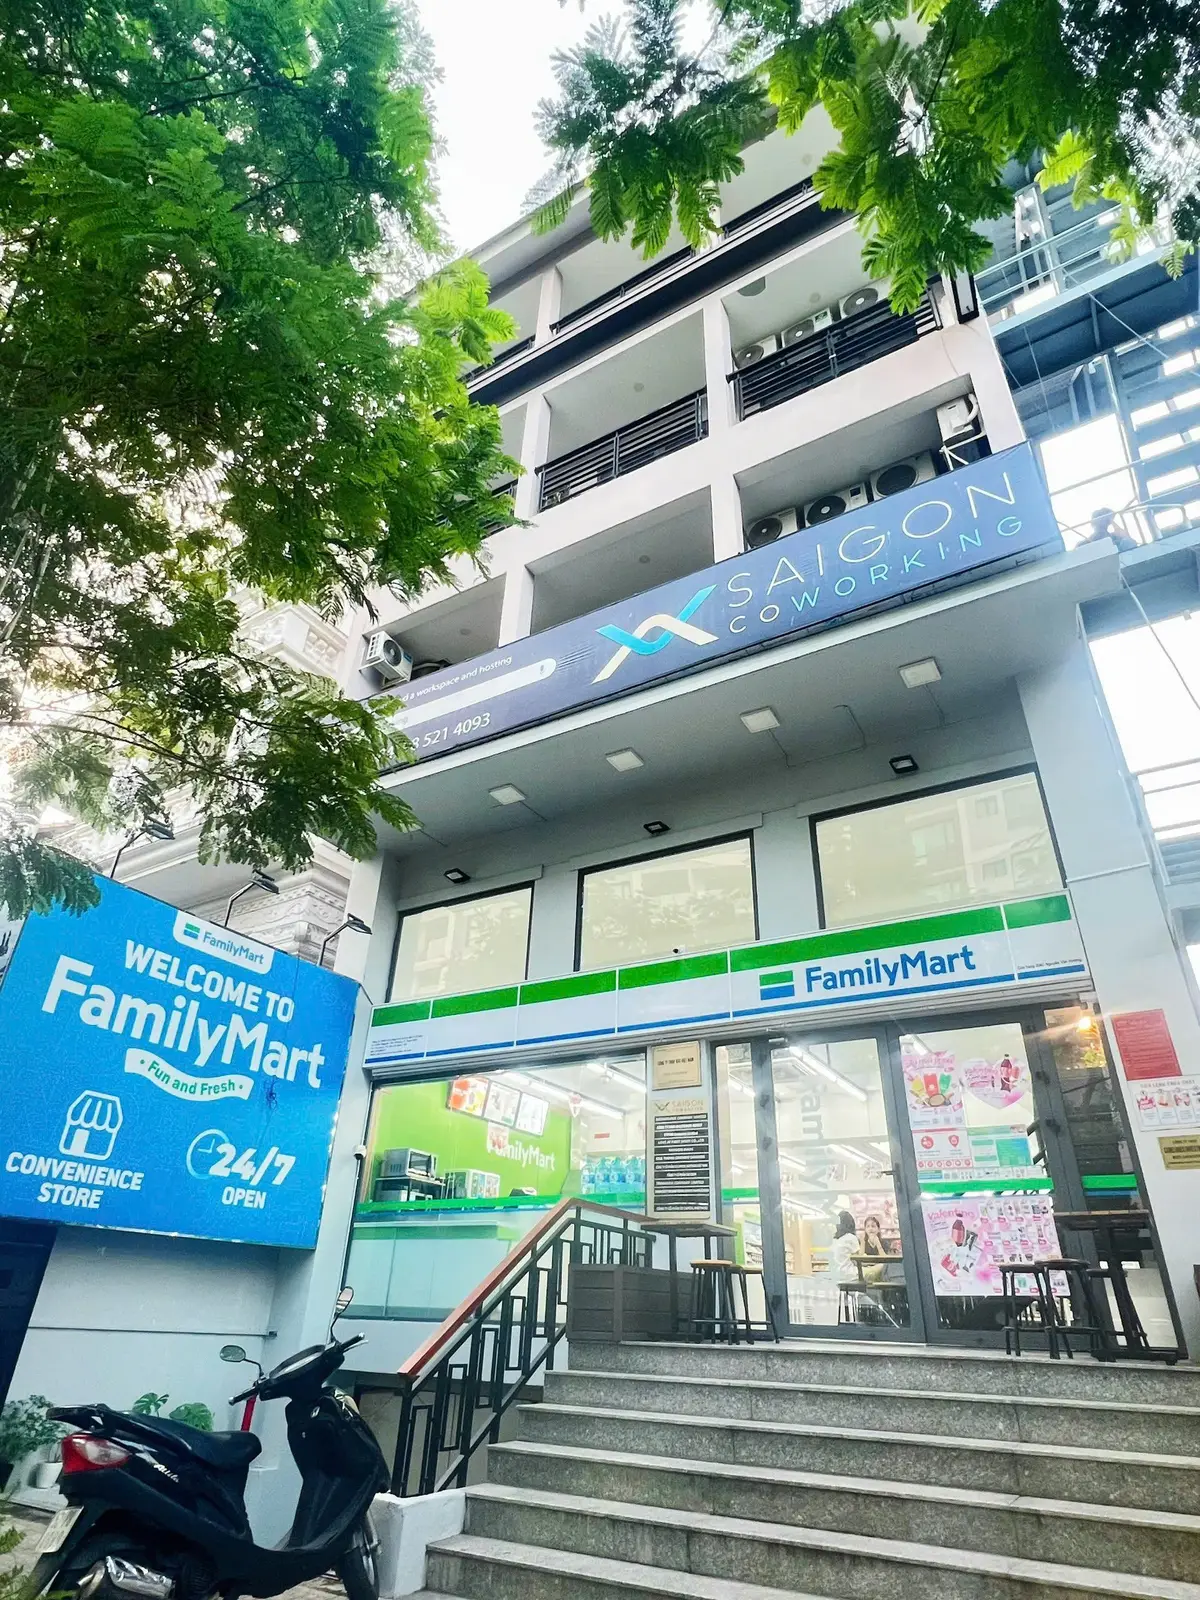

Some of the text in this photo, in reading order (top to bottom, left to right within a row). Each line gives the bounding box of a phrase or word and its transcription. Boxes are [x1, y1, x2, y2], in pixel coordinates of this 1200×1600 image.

[727, 471, 1015, 608] SAIGON
[729, 516, 1022, 633] COWORKING
[416, 676, 459, 696] workspace
[461, 667, 478, 681] and
[479, 655, 512, 674] hosting
[422, 727, 448, 748] 521
[452, 712, 491, 737] 4093
[202, 931, 265, 965] FamilyMart
[805, 944, 976, 993] FamilyMart
[124, 939, 295, 1023] WELCOME TO
[41, 954, 325, 1089] FamilyMart
[147, 1060, 236, 1095] Fun and Fresh
[5, 1151, 145, 1191] CONVENIENCE
[208, 1143, 297, 1186] 24/7
[37, 1182, 104, 1209] STORE
[221, 1186, 267, 1209] OPEN
